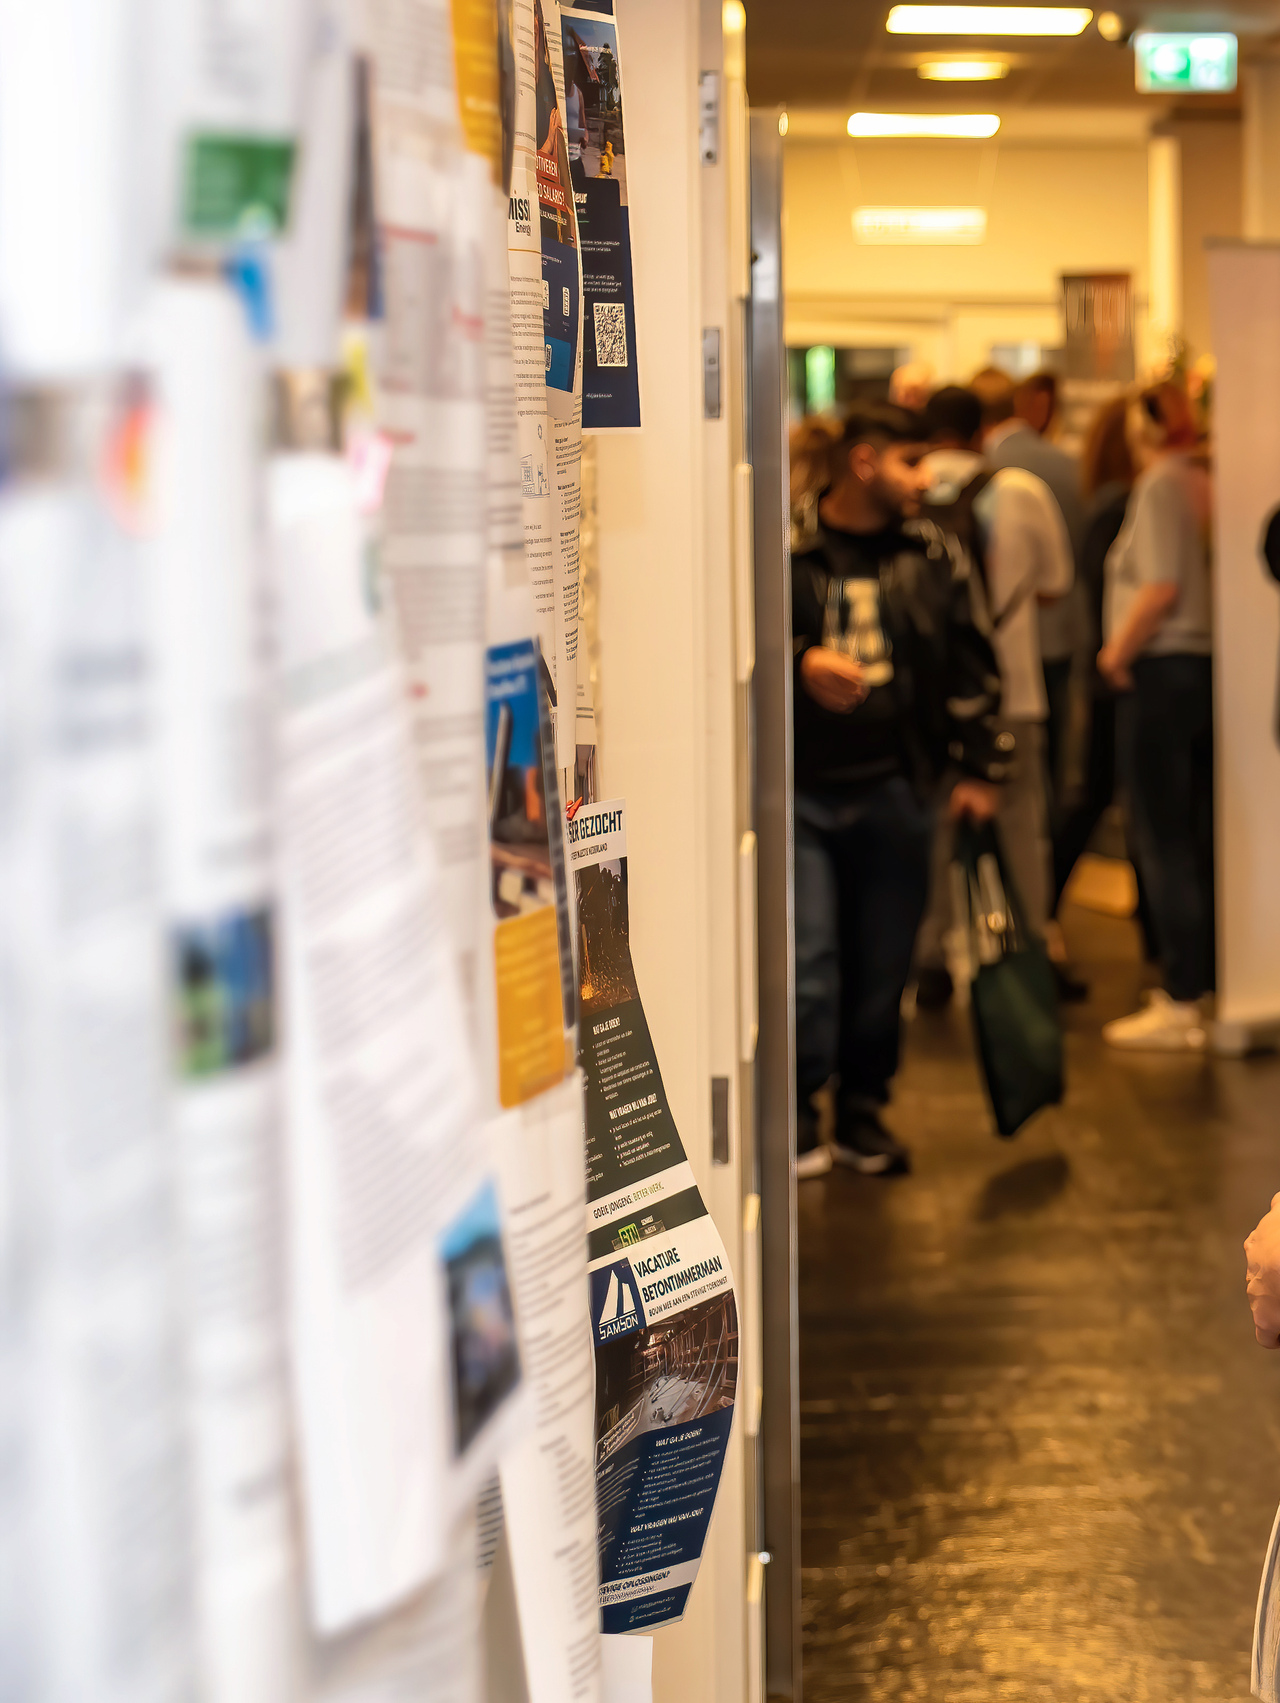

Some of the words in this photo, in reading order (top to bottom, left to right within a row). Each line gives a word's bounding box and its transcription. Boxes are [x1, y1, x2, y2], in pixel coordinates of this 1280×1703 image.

[580, 810, 622, 840] GEZOCHT
[593, 1203, 609, 1219] GOEIE
[632, 1187, 650, 1201] BETER
[634, 1247, 681, 1278] VACATURE
[642, 1255, 723, 1303] BETONTIMMERMAN
[648, 1304, 664, 1317] BOUW
[662, 1300, 673, 1311] MEE
[672, 1296, 682, 1306] AAN
[681, 1293, 691, 1303] EEN
[690, 1284, 707, 1299] STEVIGE
[706, 1275, 728, 1291] TOEKOMST
[599, 1313, 639, 1340] SAMSON
